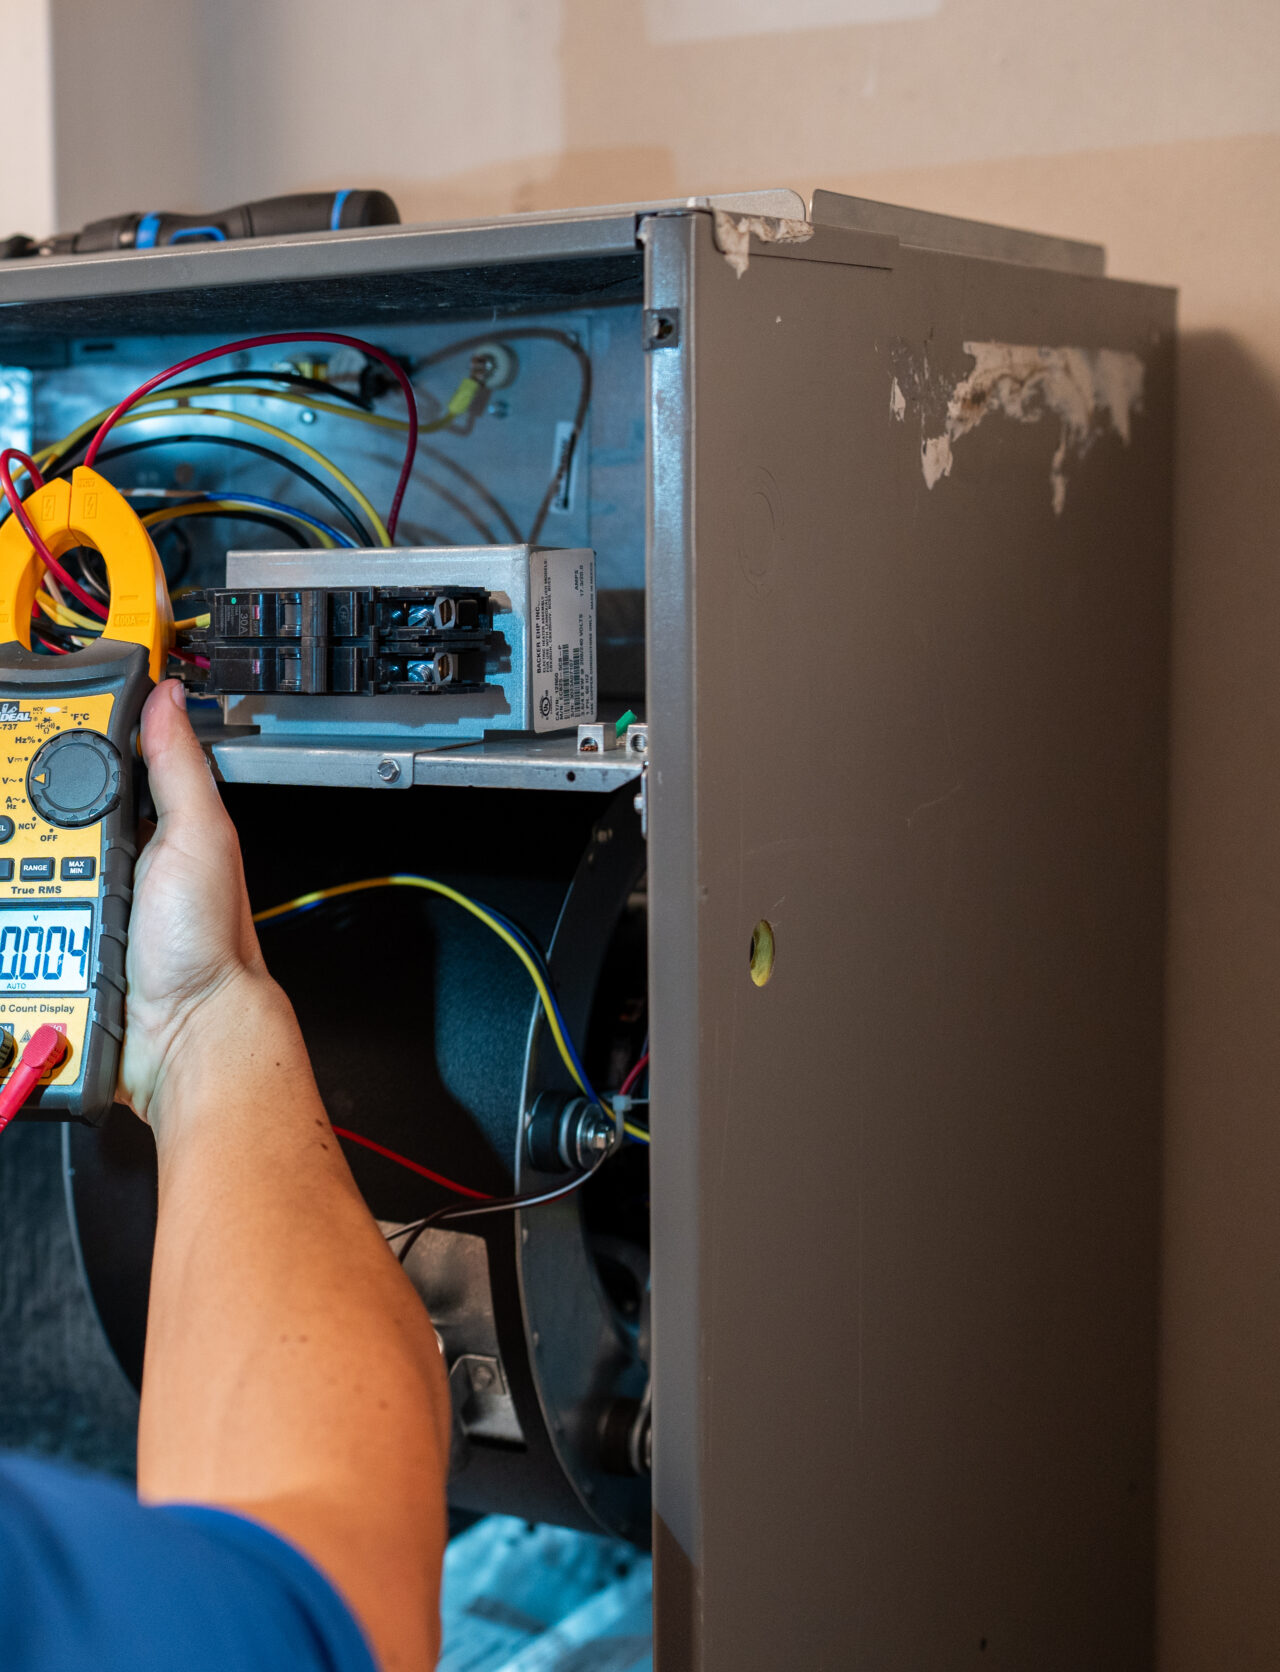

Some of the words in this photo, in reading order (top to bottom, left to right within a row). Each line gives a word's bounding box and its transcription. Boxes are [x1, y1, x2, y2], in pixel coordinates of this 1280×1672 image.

[40, 834, 58, 842] OFF
[11, 886, 35, 894] True
[38, 885, 62, 894] RMS
[6, 982, 27, 990] AUTO
[9, 1004, 37, 1013] Count
[40, 1004, 75, 1014] Display
